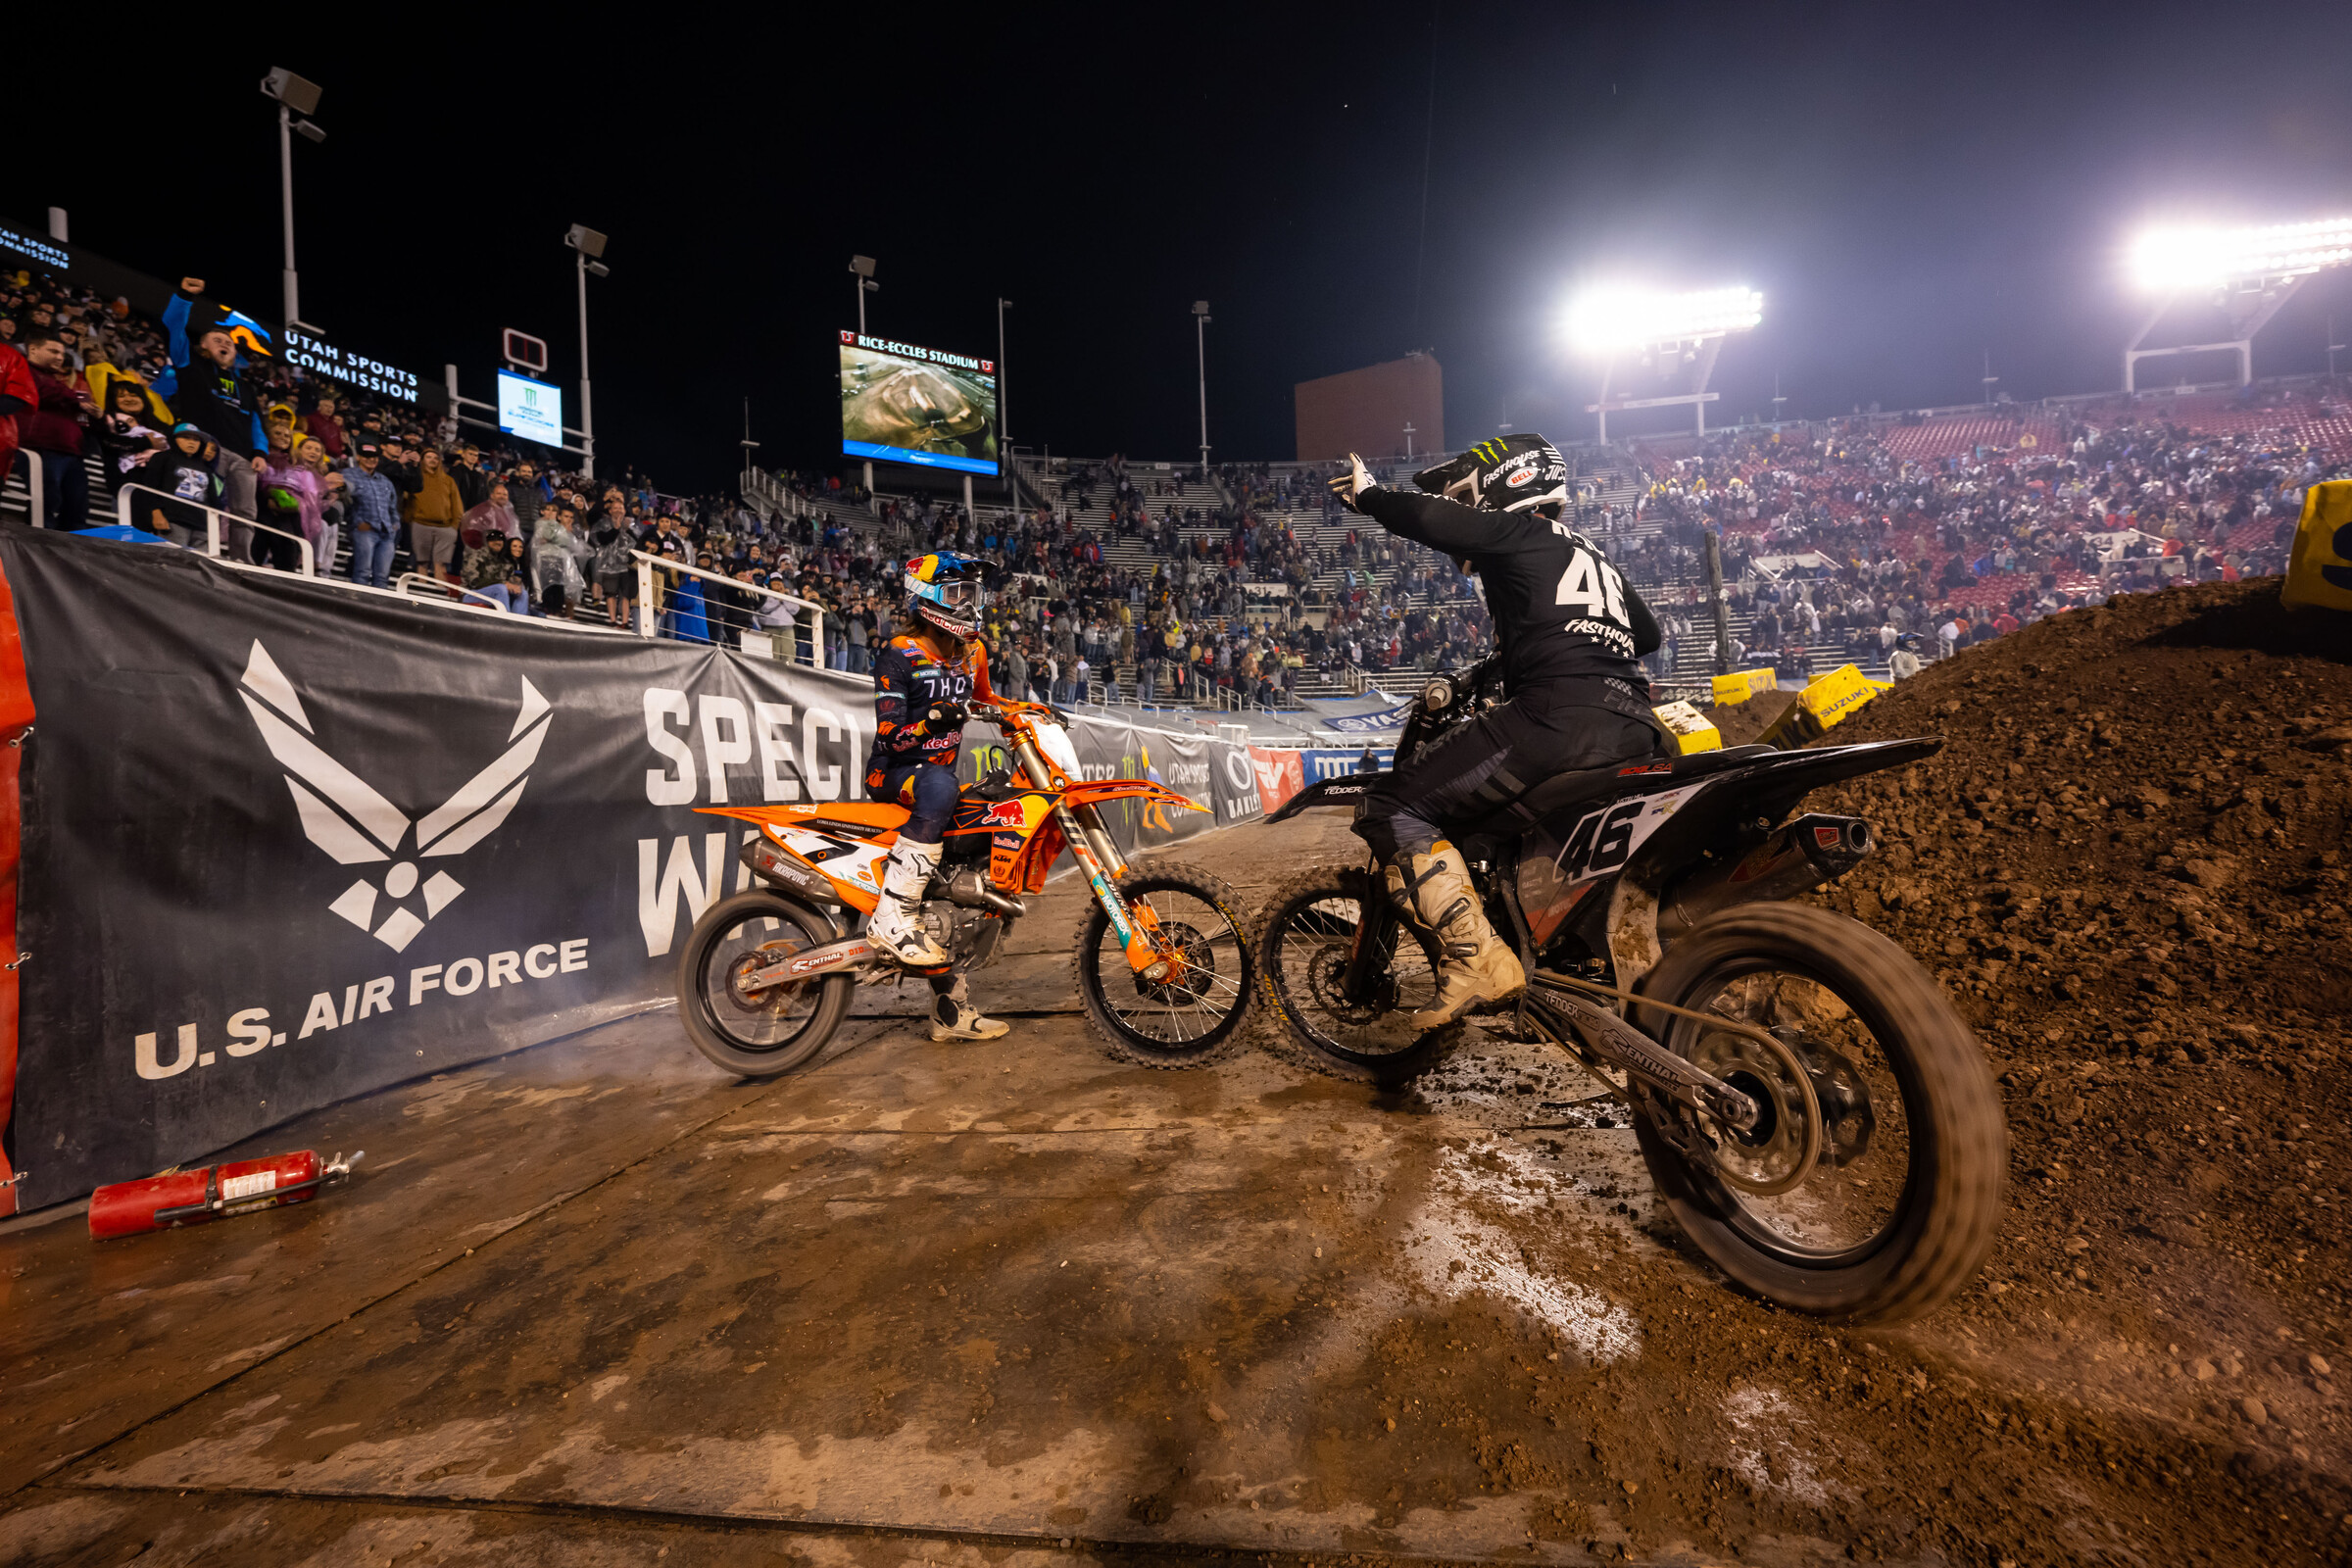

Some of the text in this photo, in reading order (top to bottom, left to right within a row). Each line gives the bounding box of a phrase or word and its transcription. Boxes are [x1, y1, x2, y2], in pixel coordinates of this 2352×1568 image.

[0, 227, 70, 261] AH SPORTS
[285, 330, 418, 387] UTAH SPORTS
[858, 334, 979, 369] RICE-ECCLES STADIUM
[285, 349, 418, 403] COMMISSION
[1483, 450, 1541, 488] FASTHOUSE
[1511, 470, 1534, 485] BELL
[1565, 618, 1635, 658] FASTHOUS
[1716, 687, 1744, 696] SUZUKI
[1820, 685, 1870, 718] SUZUKI
[643, 686, 877, 806] SPECI
[1082, 763, 1115, 782] TER
[994, 835, 1020, 849] RedBull
[1558, 801, 1646, 881] 46
[1102, 894, 1130, 936] MOTOREX
[792, 952, 844, 974] RENTHAL
[135, 938, 589, 1080] U.S. AIR FORCE
[1544, 992, 1579, 1018] TEDDER
[1600, 1029, 1679, 1082] RENTHAL
